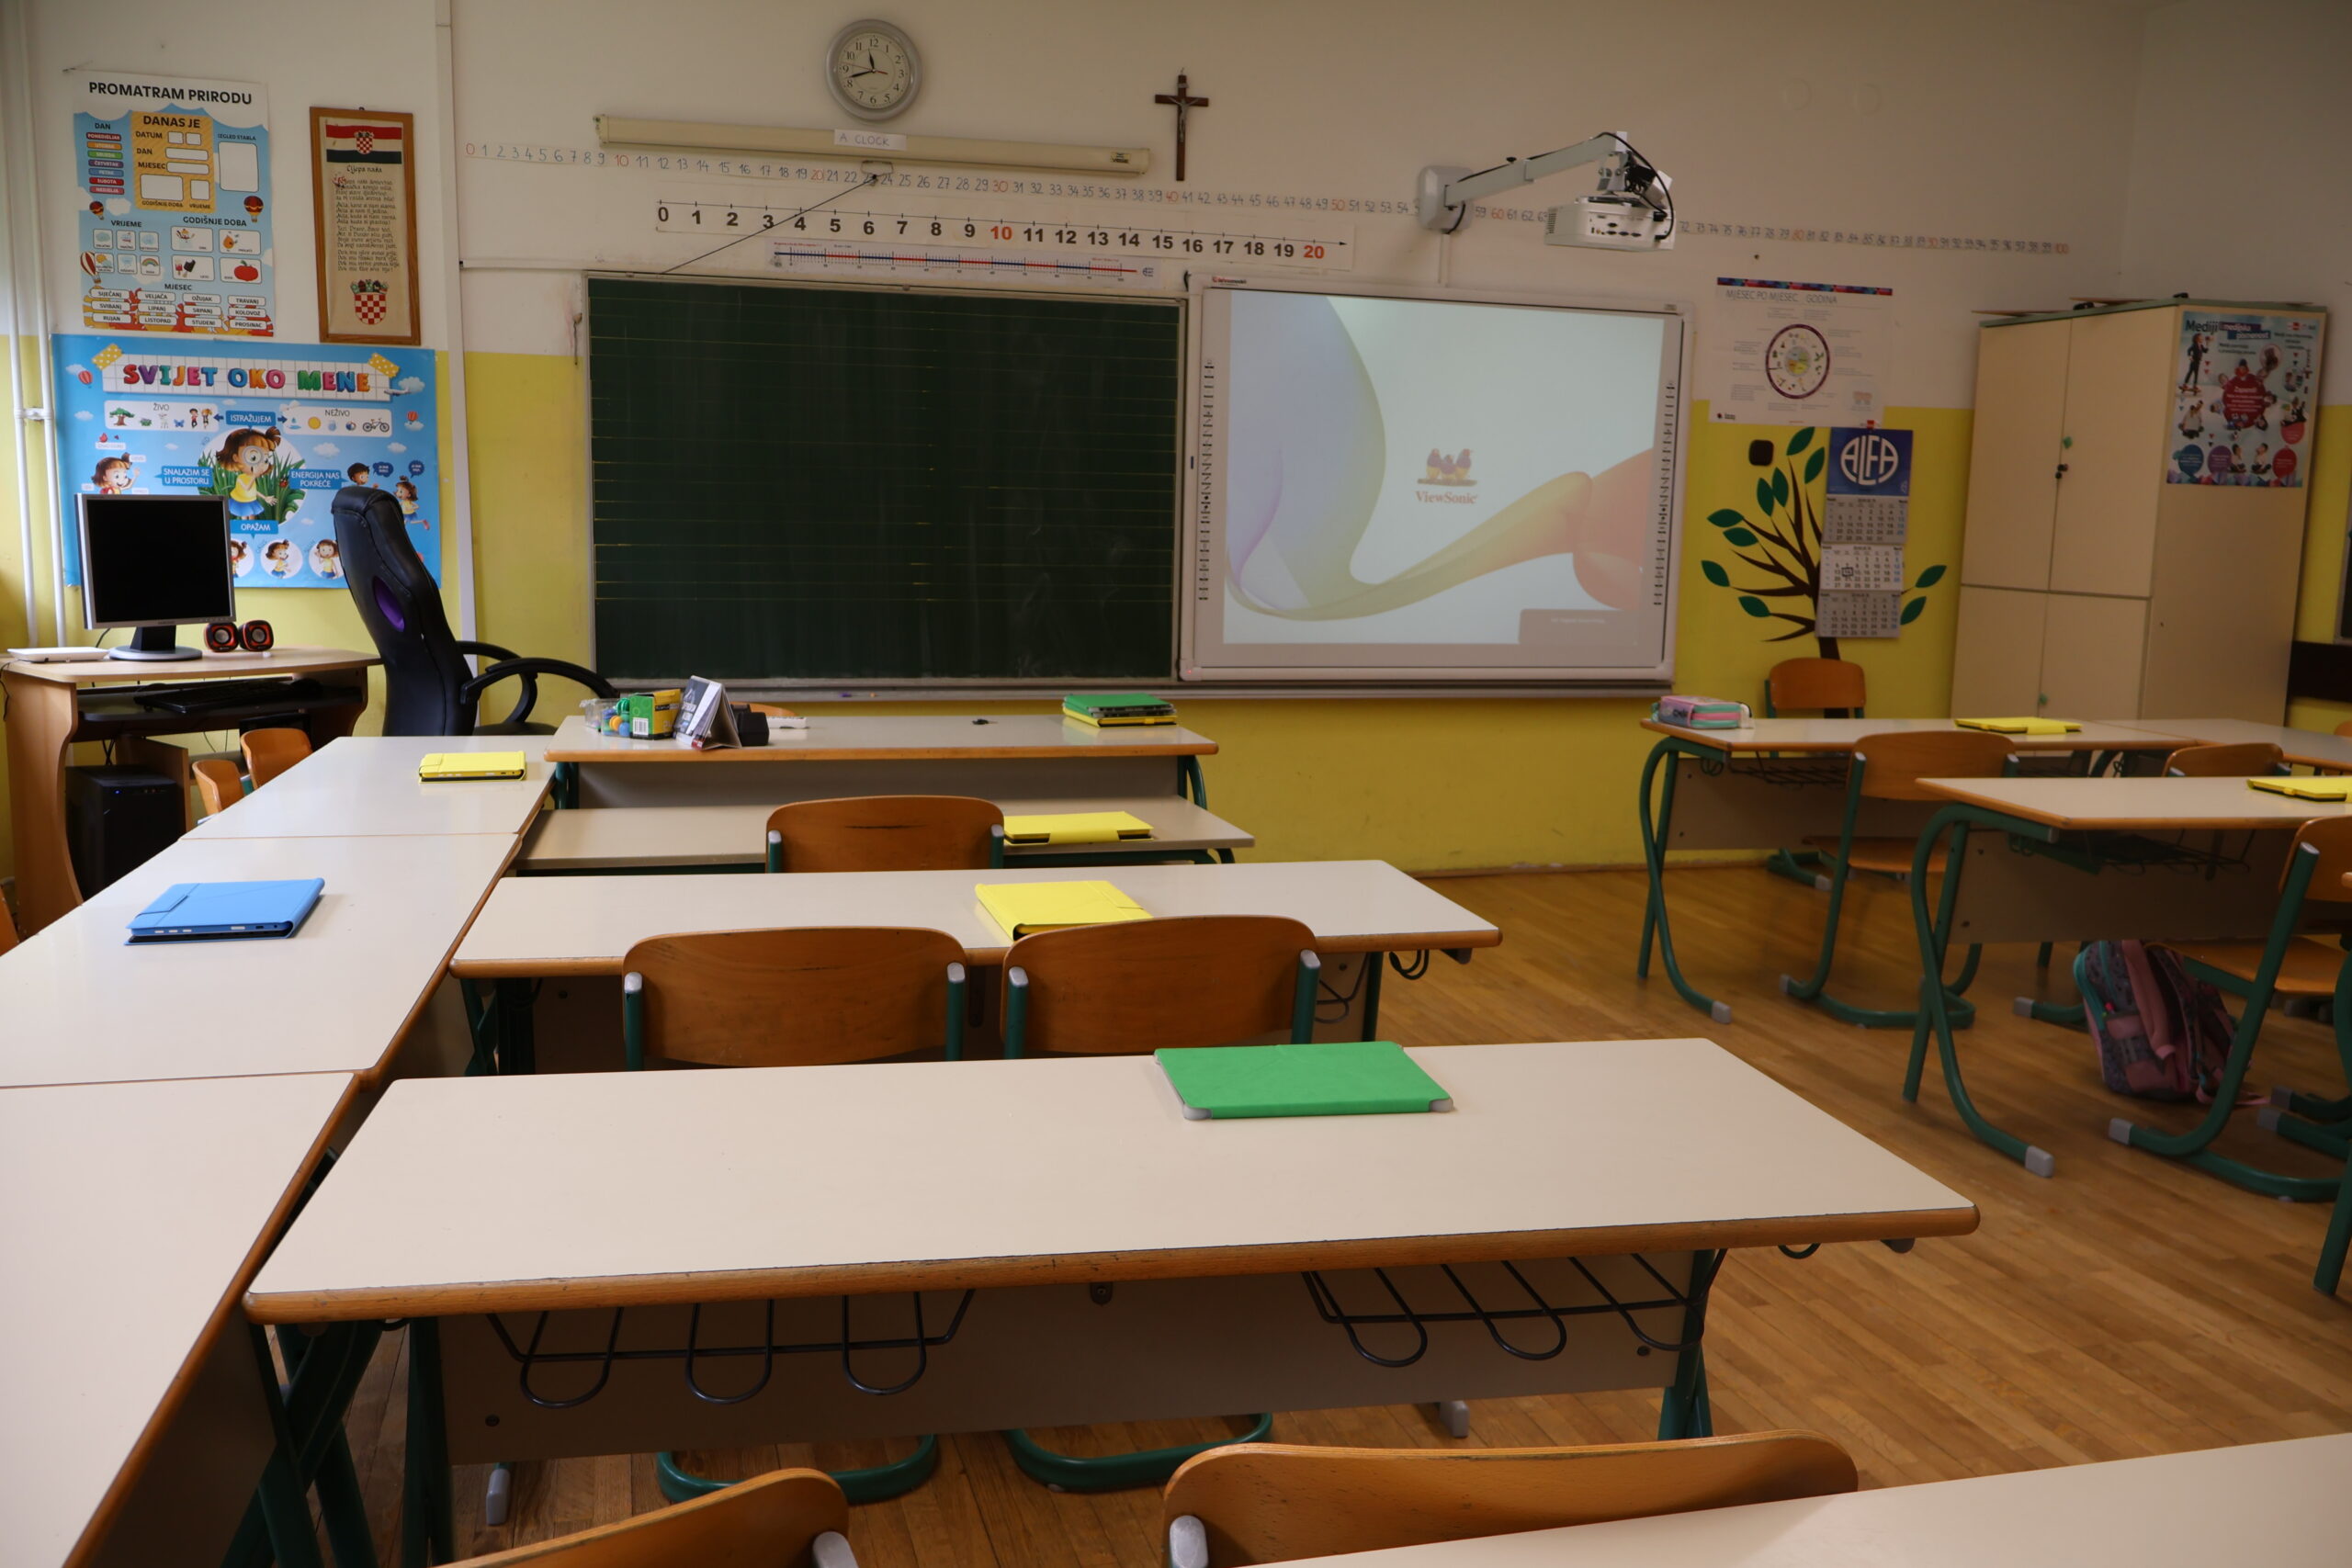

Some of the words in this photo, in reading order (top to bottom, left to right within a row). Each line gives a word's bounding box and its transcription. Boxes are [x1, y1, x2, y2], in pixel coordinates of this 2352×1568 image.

[855, 42, 862, 51] 11
[869, 39, 879, 48] 12
[885, 44, 889, 52] 1
[846, 51, 855, 60] 10
[895, 55, 901, 63] 2
[899, 69, 904, 78] 3
[847, 79, 854, 87] 8
[893, 84, 899, 92] 4
[89, 81, 184, 100] PROMATRAM
[188, 89, 253, 105] PRIRODU
[857, 91, 864, 99] 7
[884, 93, 891, 102] 5
[870, 96, 876, 104] 6
[95, 122, 111, 130] DAN
[142, 115, 185, 128] DANAS
[187, 118, 200, 129] JE
[135, 130, 163, 140] DATUM
[839, 132, 848, 141] A
[854, 135, 890, 147] CLOCK
[136, 147, 153, 155] DAN
[138, 162, 166, 170] MJESEC
[466, 142, 475, 154] 0
[481, 144, 488, 156] 1
[496, 145, 506, 157] 2
[512, 146, 520, 158] 3
[525, 147, 533, 160] 4
[538, 148, 548, 162] 5
[554, 148, 563, 162] 6
[570, 150, 577, 162] 7
[583, 152, 592, 164] 8
[597, 152, 605, 164] 9
[614, 154, 629, 166] 10
[636, 155, 649, 168] 11
[657, 156, 670, 169] 12
[676, 157, 689, 170] 13
[696, 160, 709, 173] 14
[718, 161, 729, 174] 15
[739, 164, 752, 175] 16
[760, 164, 772, 176] 17
[779, 166, 790, 178] 18
[796, 167, 808, 179] 19
[810, 168, 824, 181] 20
[826, 169, 838, 182] 21
[844, 171, 857, 183] 22
[881, 174, 893, 186] 24
[899, 175, 911, 187] 25
[917, 175, 930, 188] 26
[937, 177, 949, 189] 27
[956, 178, 969, 191] 28
[975, 179, 989, 192] 29
[992, 180, 1008, 193] 30
[1013, 181, 1023, 194] 31
[1031, 182, 1044, 195] 32
[1049, 184, 1062, 197] 33
[1068, 184, 1079, 197] 34
[1082, 186, 1094, 198] 35
[1098, 186, 1111, 198] 36
[1114, 186, 1126, 199] 37
[1132, 189, 1145, 201] 38
[1148, 190, 1162, 202] 39
[1166, 191, 1179, 203] 40
[1182, 191, 1193, 204] 41
[1197, 192, 1211, 204] 42
[1216, 193, 1227, 205] 43
[1249, 194, 1261, 207] 45
[1266, 195, 1280, 208] 46
[1283, 196, 1295, 208] 47
[1299, 197, 1312, 209] 48
[1315, 197, 1329, 209] 49
[1331, 198, 1345, 211] 50
[1348, 199, 1360, 212] 51
[1364, 200, 1376, 212] 52
[1396, 201, 1408, 214] 54
[110, 220, 142, 228] VRIJEME
[182, 214, 222, 226] GODIŠNJE
[223, 218, 247, 227] DOBA
[658, 207, 669, 221] 0
[692, 210, 701, 224] 1
[727, 211, 739, 226] 2
[763, 214, 775, 230] 3
[794, 216, 807, 231] 4
[830, 219, 842, 232] 5
[863, 220, 875, 234] 6
[897, 221, 908, 235] 7
[931, 222, 942, 236] 8
[964, 223, 976, 238] 9
[990, 225, 1012, 241] 10
[1023, 228, 1044, 243] 11
[1055, 230, 1077, 244] 12
[1087, 231, 1109, 246] 13
[1118, 232, 1140, 248] 14
[1152, 234, 1173, 250] 15
[1182, 238, 1204, 254] 16
[1213, 240, 1234, 254] 17
[1243, 242, 1265, 256] 18
[1273, 243, 1295, 257] 19
[1303, 244, 1326, 259] 20
[164, 283, 192, 291] MJESEC
[97, 290, 122, 299] SIJEČANJ
[1725, 289, 1756, 301] MJESEC
[1757, 290, 1769, 300] PO
[1770, 291, 1799, 303] MJESEC
[1805, 293, 1838, 304] GODINA
[123, 364, 218, 388] SVIJET
[227, 367, 286, 389] OKO
[296, 369, 370, 393] MENE
[153, 401, 170, 412] ŽIVO
[324, 407, 350, 418] NEŽIVO
[230, 412, 273, 423] ISTRAŽUJEM
[1840, 434, 1899, 486] ALFA
[164, 468, 200, 477] SNALAZIM
[290, 470, 323, 479] ENERGIJA
[164, 477, 170, 485] U
[171, 477, 209, 486] PROSTORU
[300, 478, 332, 488] POKREĆE
[1415, 491, 1477, 505] ViewSonic
[241, 522, 271, 532] OPAŽAM
